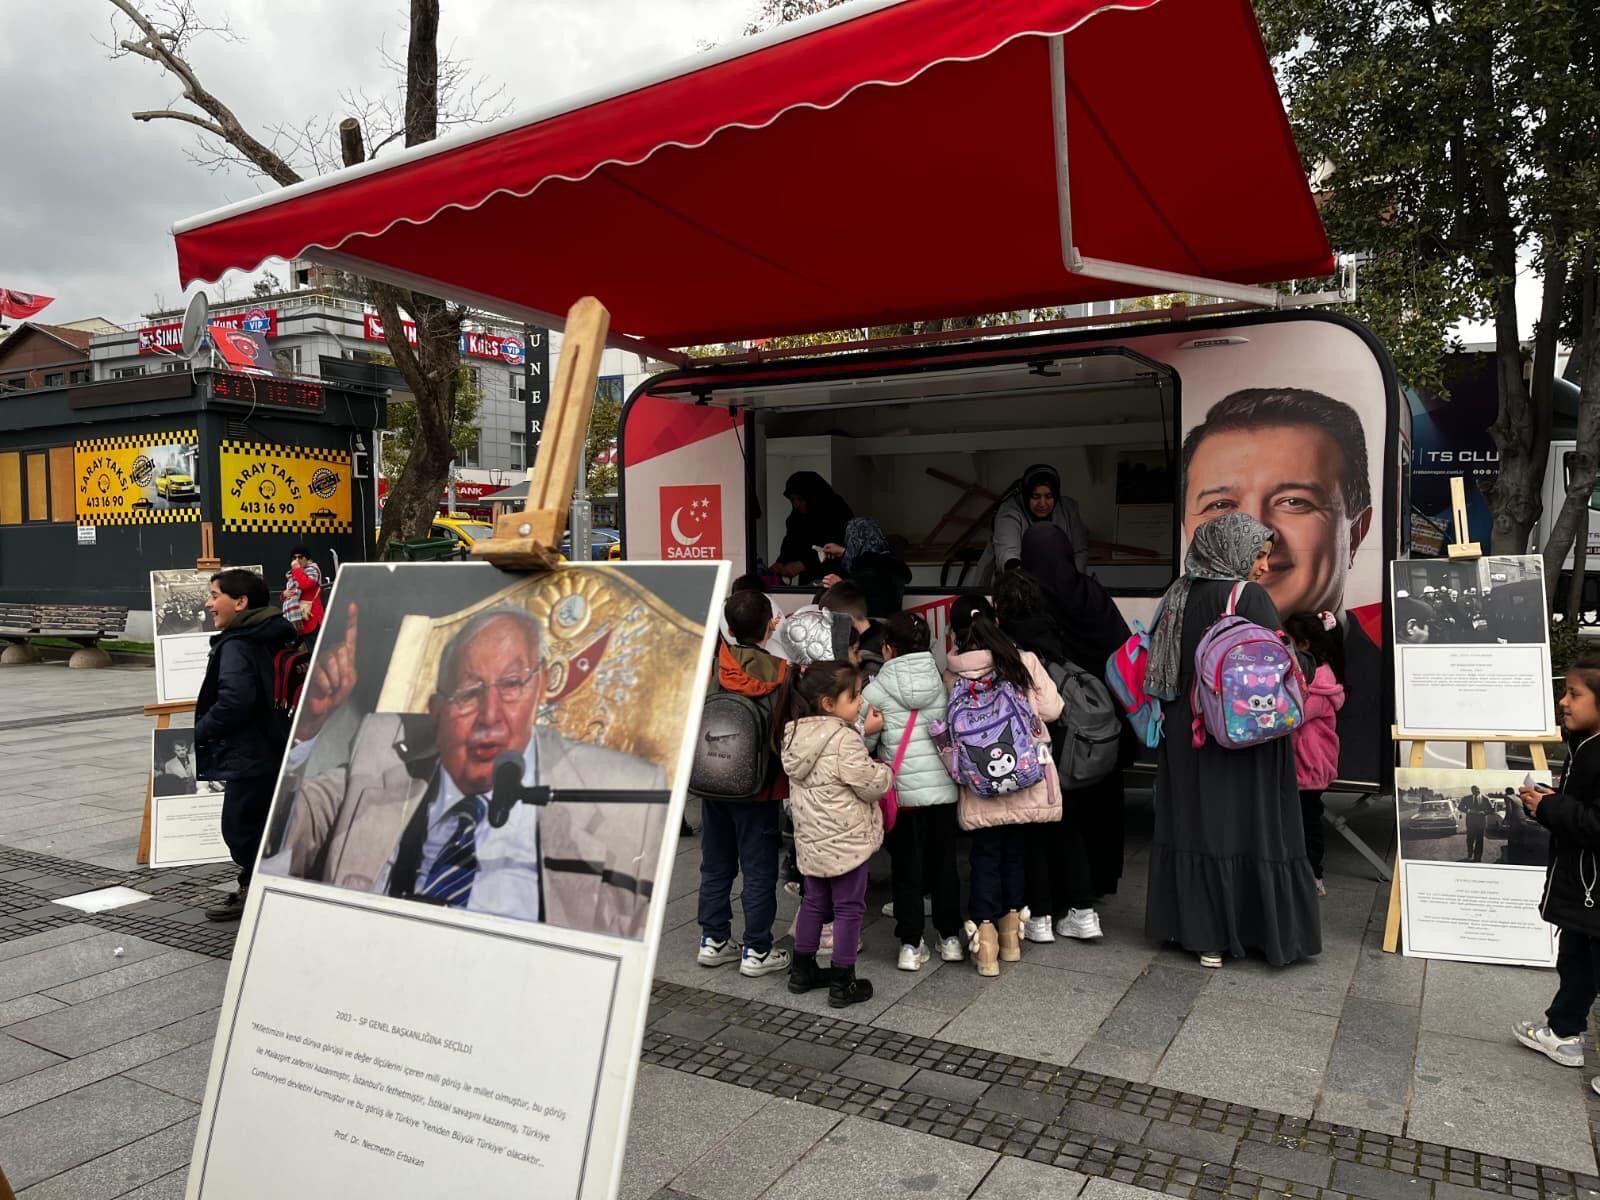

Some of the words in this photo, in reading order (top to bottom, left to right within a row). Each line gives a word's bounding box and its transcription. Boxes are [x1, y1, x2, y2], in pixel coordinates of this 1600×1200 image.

[529, 333, 542, 446] UNER
[1427, 451, 1453, 462] TS
[1458, 450, 1500, 462] CLU
[81, 457, 103, 494] SARAY
[231, 462, 267, 498] SARAY
[86, 496, 100, 508] 413
[102, 495, 110, 507] 16
[112, 495, 124, 506] 90
[240, 502, 260, 513] 413
[264, 503, 275, 513] 16
[279, 503, 294, 514] 90
[667, 546, 716, 559] SAADET
[336, 1011, 352, 1022] 2003
[358, 1016, 368, 1026] SP
[368, 1019, 389, 1032] GENEL
[302, 1038, 321, 1050] dünya
[345, 1050, 353, 1058] ve
[353, 1051, 372, 1064] değer
[441, 1077, 461, 1091] görüş
[462, 1083, 472, 1093] ile
[473, 1086, 494, 1100] millet
[532, 1101, 543, 1113] bu
[544, 1107, 567, 1121] görüş
[347, 1098, 355, 1107] ve
[355, 1099, 365, 1110] bu
[365, 1104, 384, 1118] görüş
[385, 1108, 394, 1119] ile
[394, 1112, 420, 1128] Türkiye
[451, 1130, 475, 1144] Büyük
[522, 1125, 551, 1142] Türkiye
[334, 1129, 349, 1141] Prof.
[350, 1135, 361, 1145] Dr.
[362, 1139, 396, 1157] Necmettin
[396, 1151, 425, 1168] Erbakan
